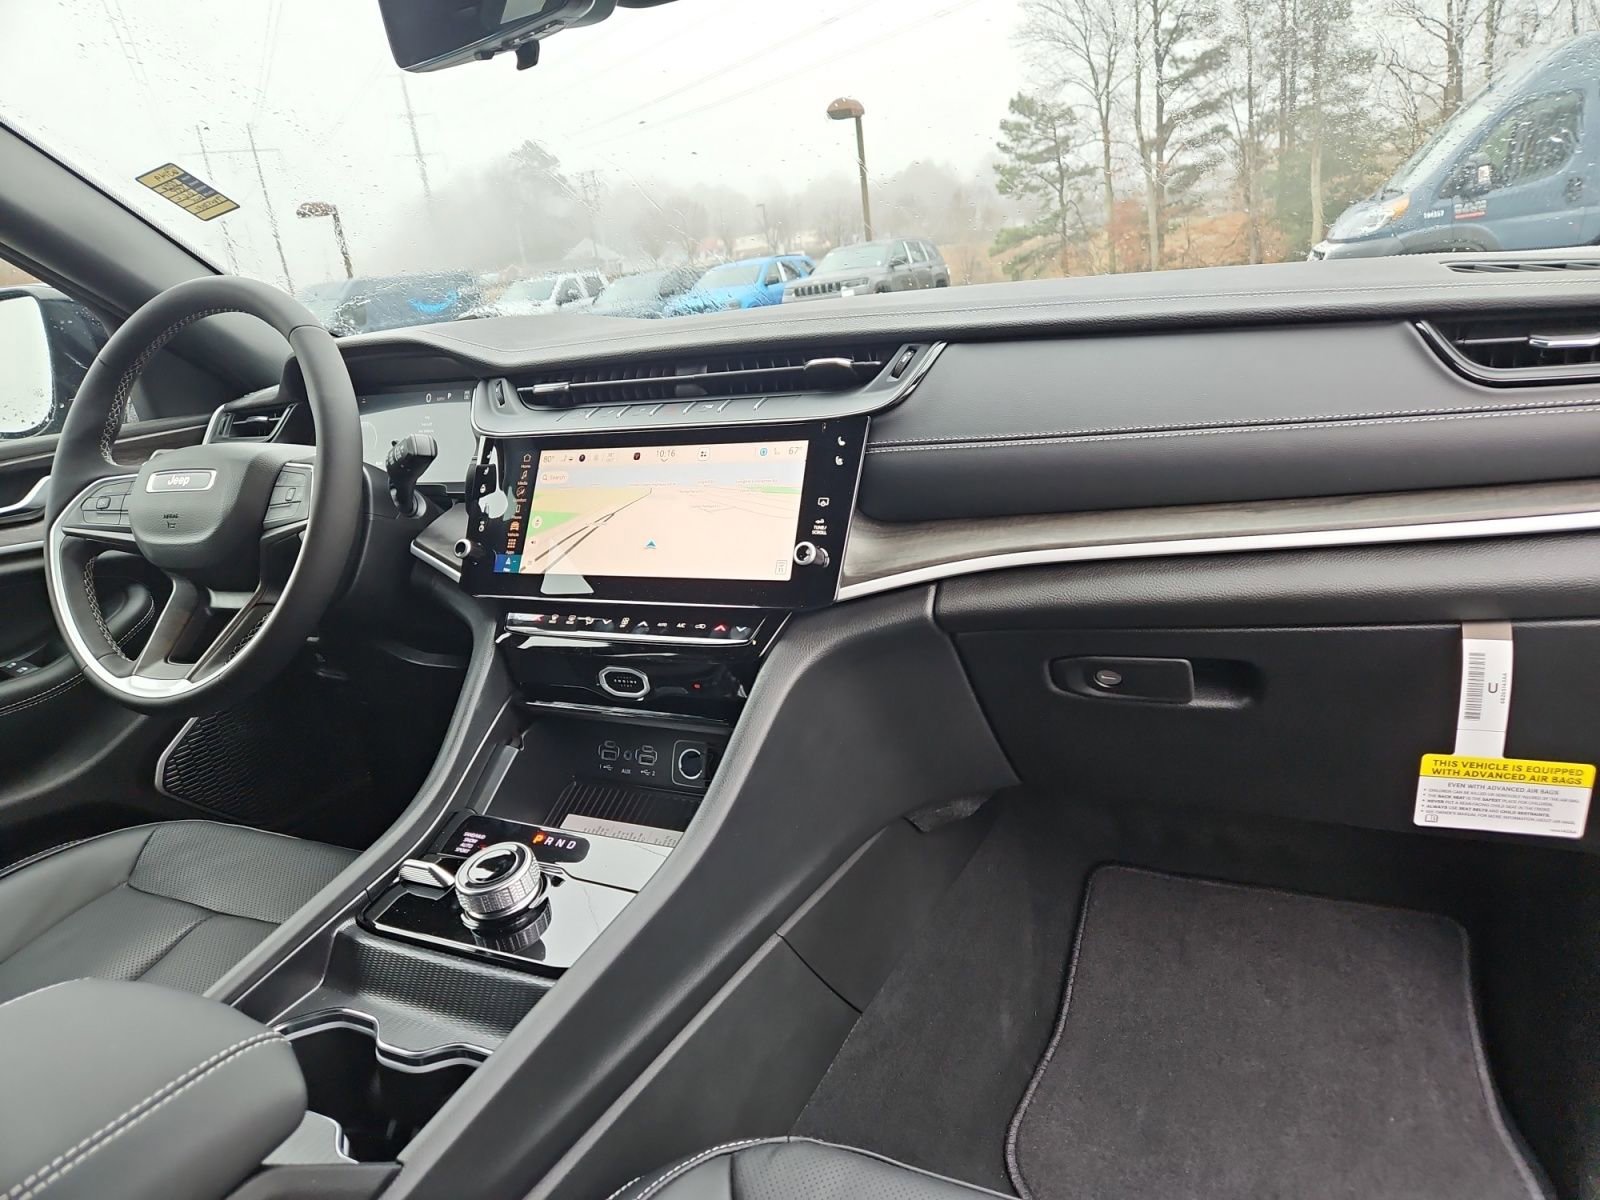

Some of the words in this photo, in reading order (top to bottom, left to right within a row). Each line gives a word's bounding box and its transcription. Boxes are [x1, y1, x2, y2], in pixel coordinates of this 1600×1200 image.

[426, 393, 432, 402] 0
[657, 450, 676, 458] 10:16
[168, 476, 190, 486] Jeep
[1432, 768, 1460, 776] WITH
[1464, 770, 1526, 780] ADVANCED
[1462, 762, 1508, 771] VEHICLE
[1526, 766, 1584, 776] EQUIPPED
